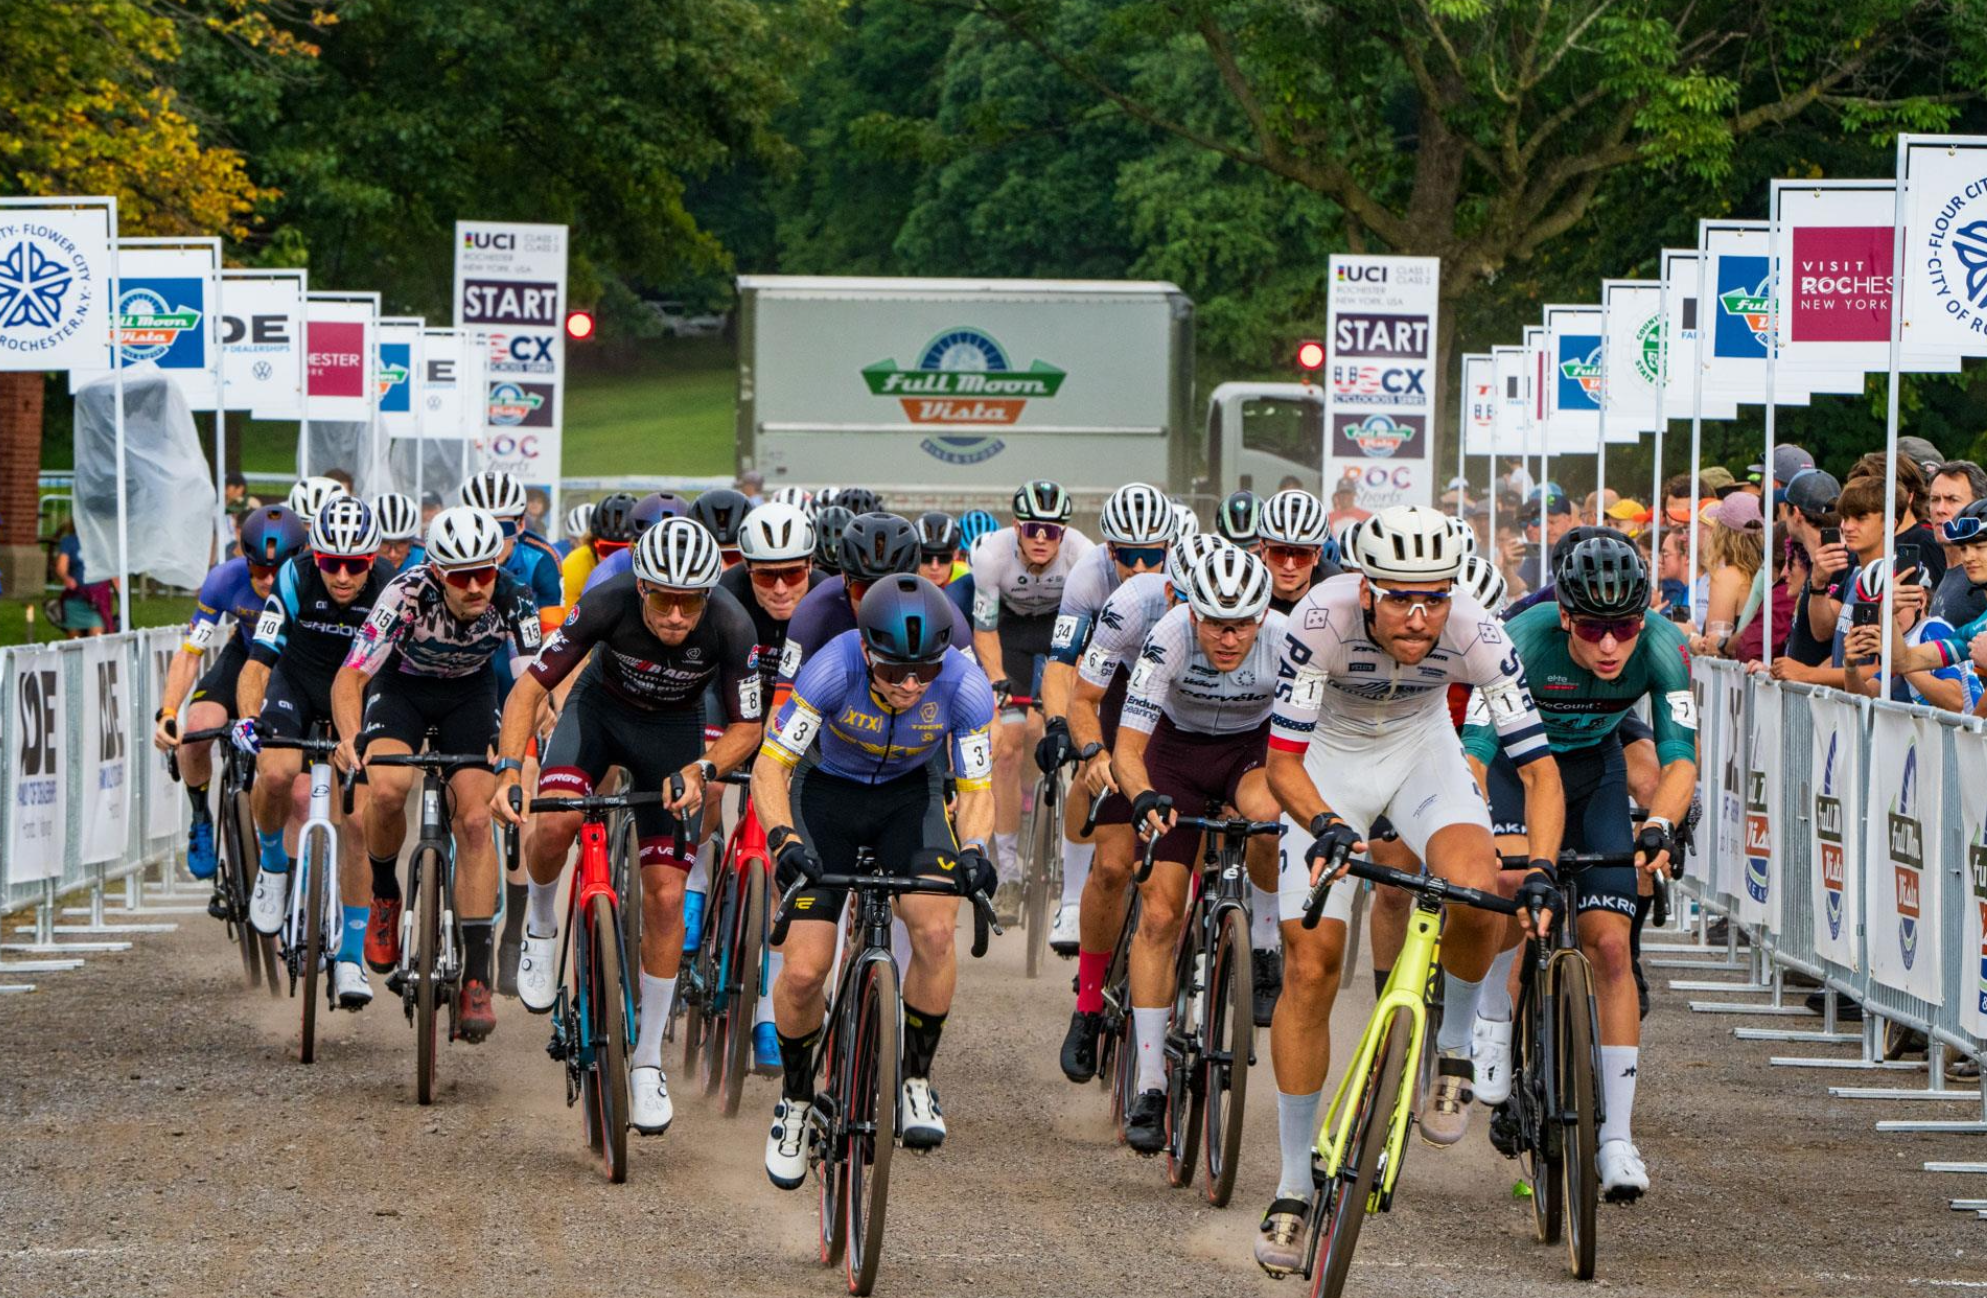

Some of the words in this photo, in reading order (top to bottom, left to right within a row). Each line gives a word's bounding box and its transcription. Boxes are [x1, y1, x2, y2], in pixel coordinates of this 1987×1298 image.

[1929, 196, 1966, 248] FLOUR
[475, 233, 515, 250] UCI
[24, 224, 75, 254] FLOWER
[72, 254, 91, 281] CITY
[1347, 266, 1387, 283] UCI
[1803, 261, 1864, 272] VISIT
[1927, 258, 1951, 296] CITY
[1946, 300, 1970, 321] OF
[464, 285, 556, 320] START
[1801, 300, 1835, 310] NEW
[1845, 300, 1887, 310] YORK
[1336, 319, 1428, 352] START
[882, 374, 950, 391] Full
[955, 375, 1048, 393] Moon
[919, 402, 1009, 421] Vista
[261, 619, 277, 635] 10
[376, 608, 392, 628] 15
[198, 628, 213, 643] 17
[525, 623, 540, 642] 15
[1055, 624, 1071, 640] 34
[782, 650, 792, 668] 4
[1089, 651, 1099, 668] 6
[1132, 668, 1143, 687] 2
[1307, 679, 1317, 700] 1
[749, 691, 758, 710] 8
[1500, 692, 1514, 713] 1
[1679, 701, 1690, 718] 7
[793, 721, 809, 742] 3
[973, 745, 985, 767] 3
[540, 773, 583, 785] VERGE
